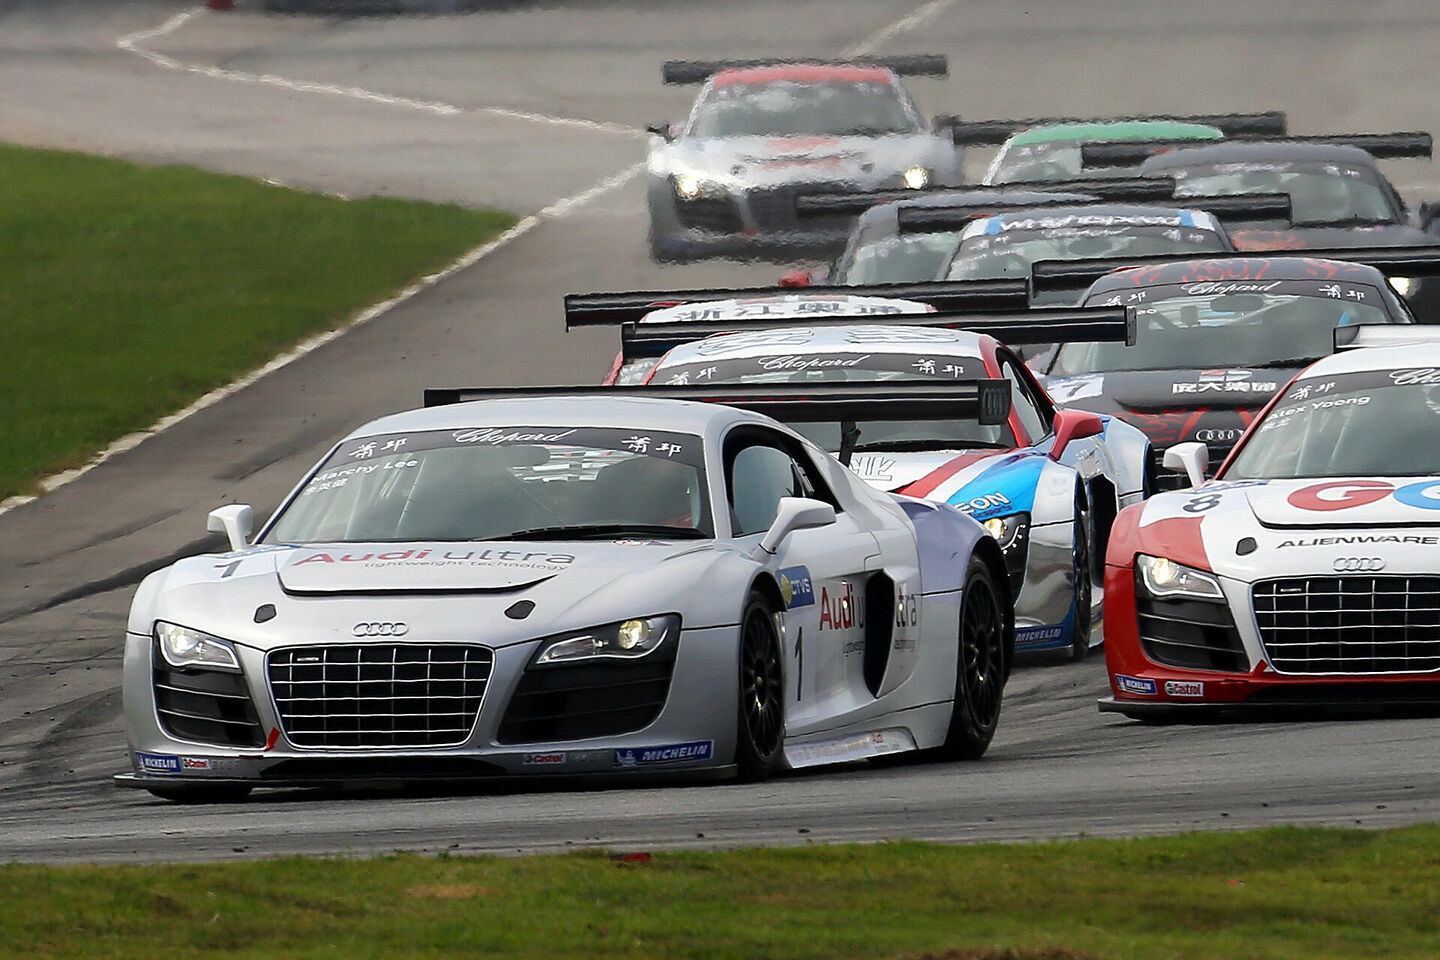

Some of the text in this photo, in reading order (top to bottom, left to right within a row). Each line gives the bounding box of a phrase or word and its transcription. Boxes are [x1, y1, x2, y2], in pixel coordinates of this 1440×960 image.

[757, 354, 870, 370] Chopard
[1267, 395, 1371, 422] Alex Yoong
[452, 428, 578, 446] Chopard
[311, 459, 419, 485] Marchy Lee
[1182, 493, 1222, 514] 8
[1274, 536, 1440, 550] ALIENWARE
[293, 548, 576, 566] Audi ultra
[214, 559, 243, 579] 1
[470, 561, 566, 573] technology
[819, 583, 856, 632] Audi
[1015, 628, 1062, 643] MICHELIN
[1173, 683, 1201, 695] Castrol
[641, 744, 708, 761] MICHELIN
